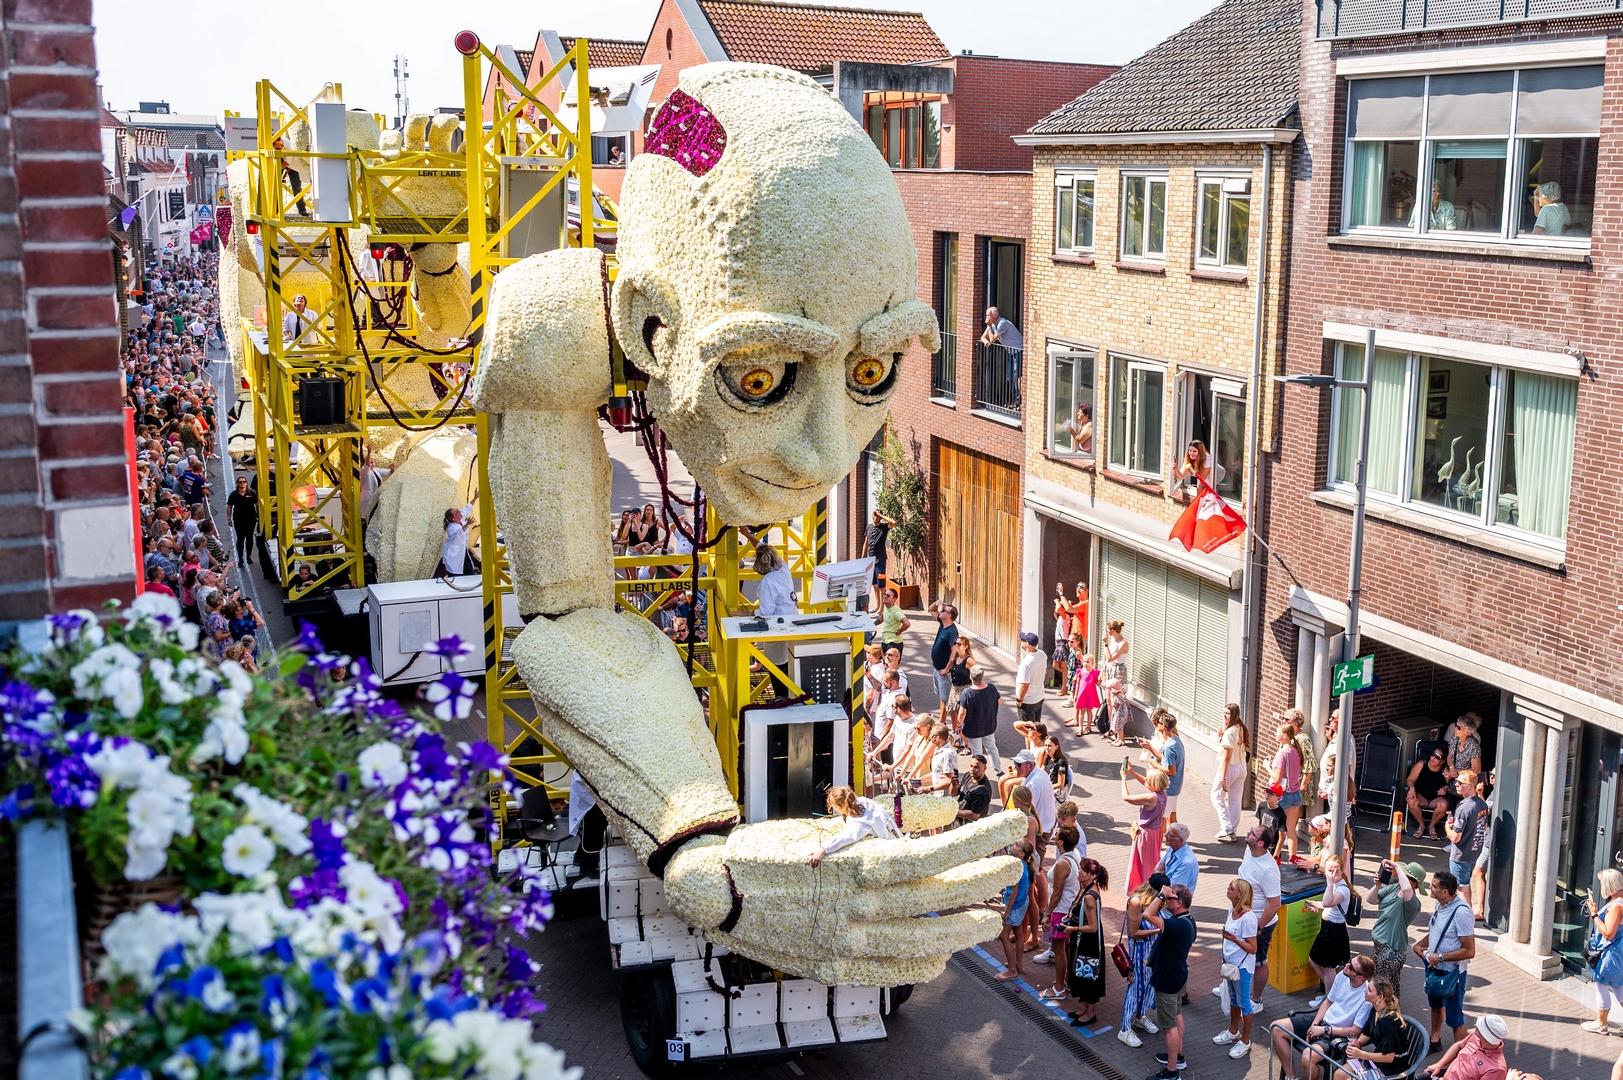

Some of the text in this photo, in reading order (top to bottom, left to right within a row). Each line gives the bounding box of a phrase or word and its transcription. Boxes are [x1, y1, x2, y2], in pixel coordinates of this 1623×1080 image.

[628, 581, 691, 592] LENT LABS
[669, 1043, 684, 1053] 03
